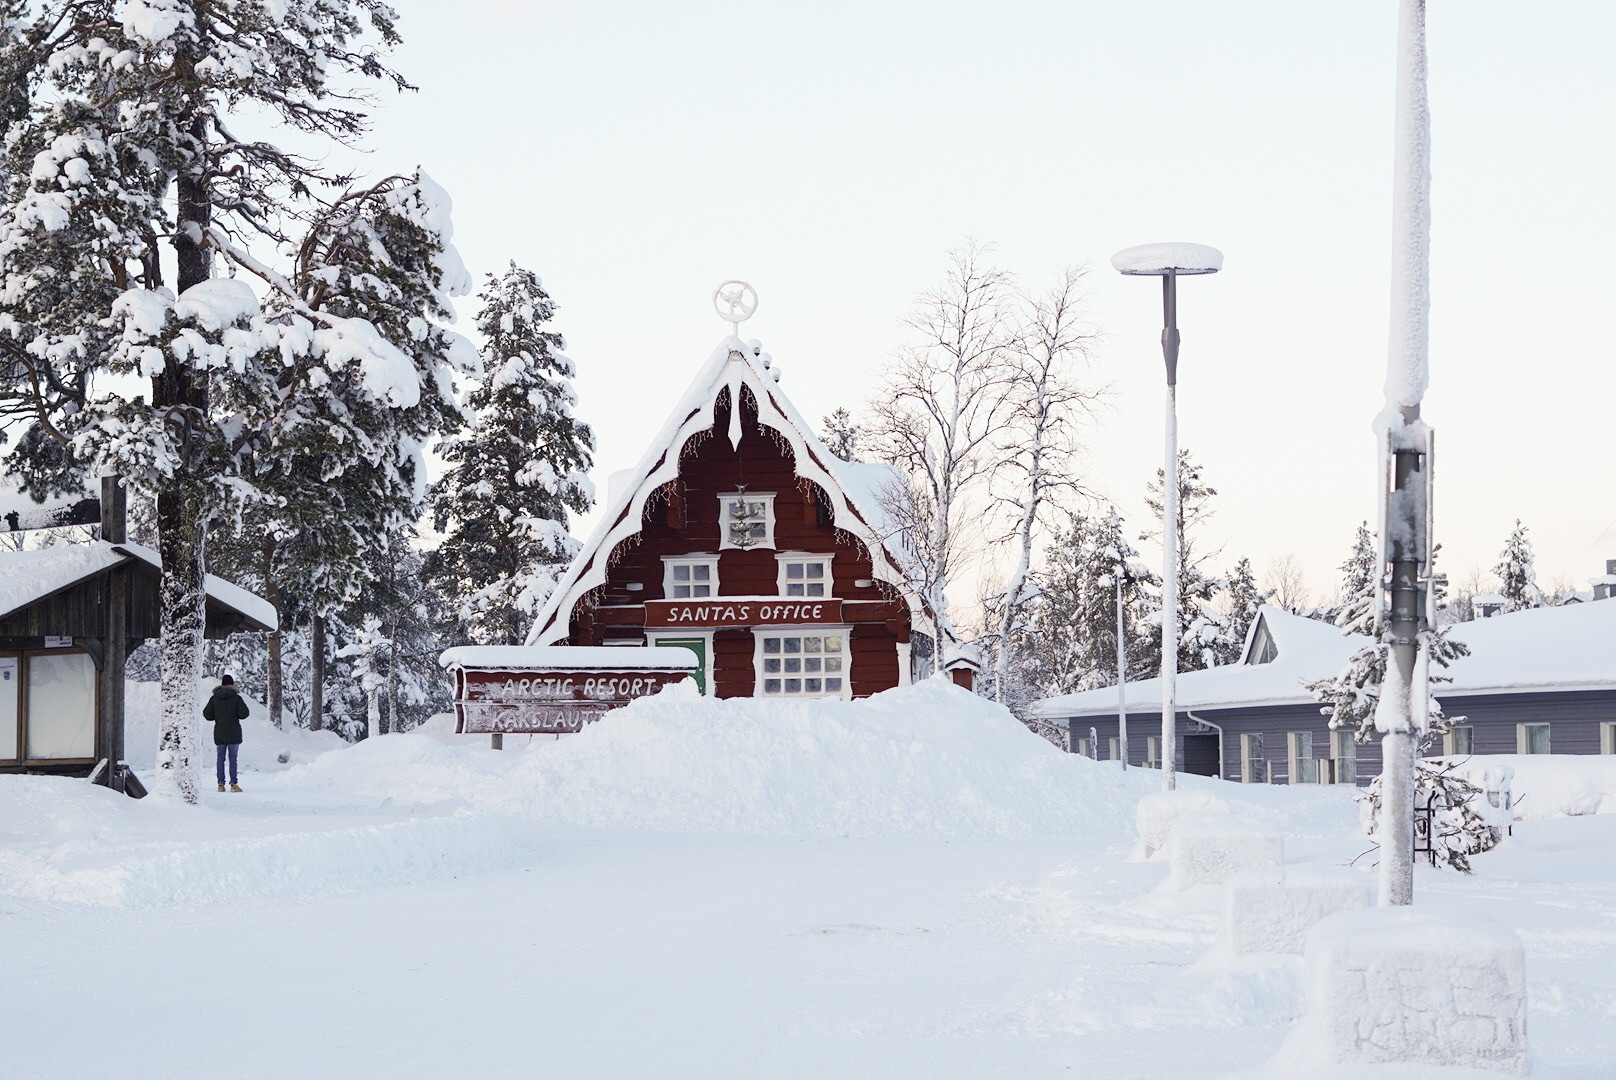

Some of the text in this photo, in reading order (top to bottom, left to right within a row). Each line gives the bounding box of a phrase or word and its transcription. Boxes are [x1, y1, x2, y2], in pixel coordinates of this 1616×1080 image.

[667, 605, 750, 622] SANTA'S
[501, 678, 657, 696] ARCTIC RESORT
